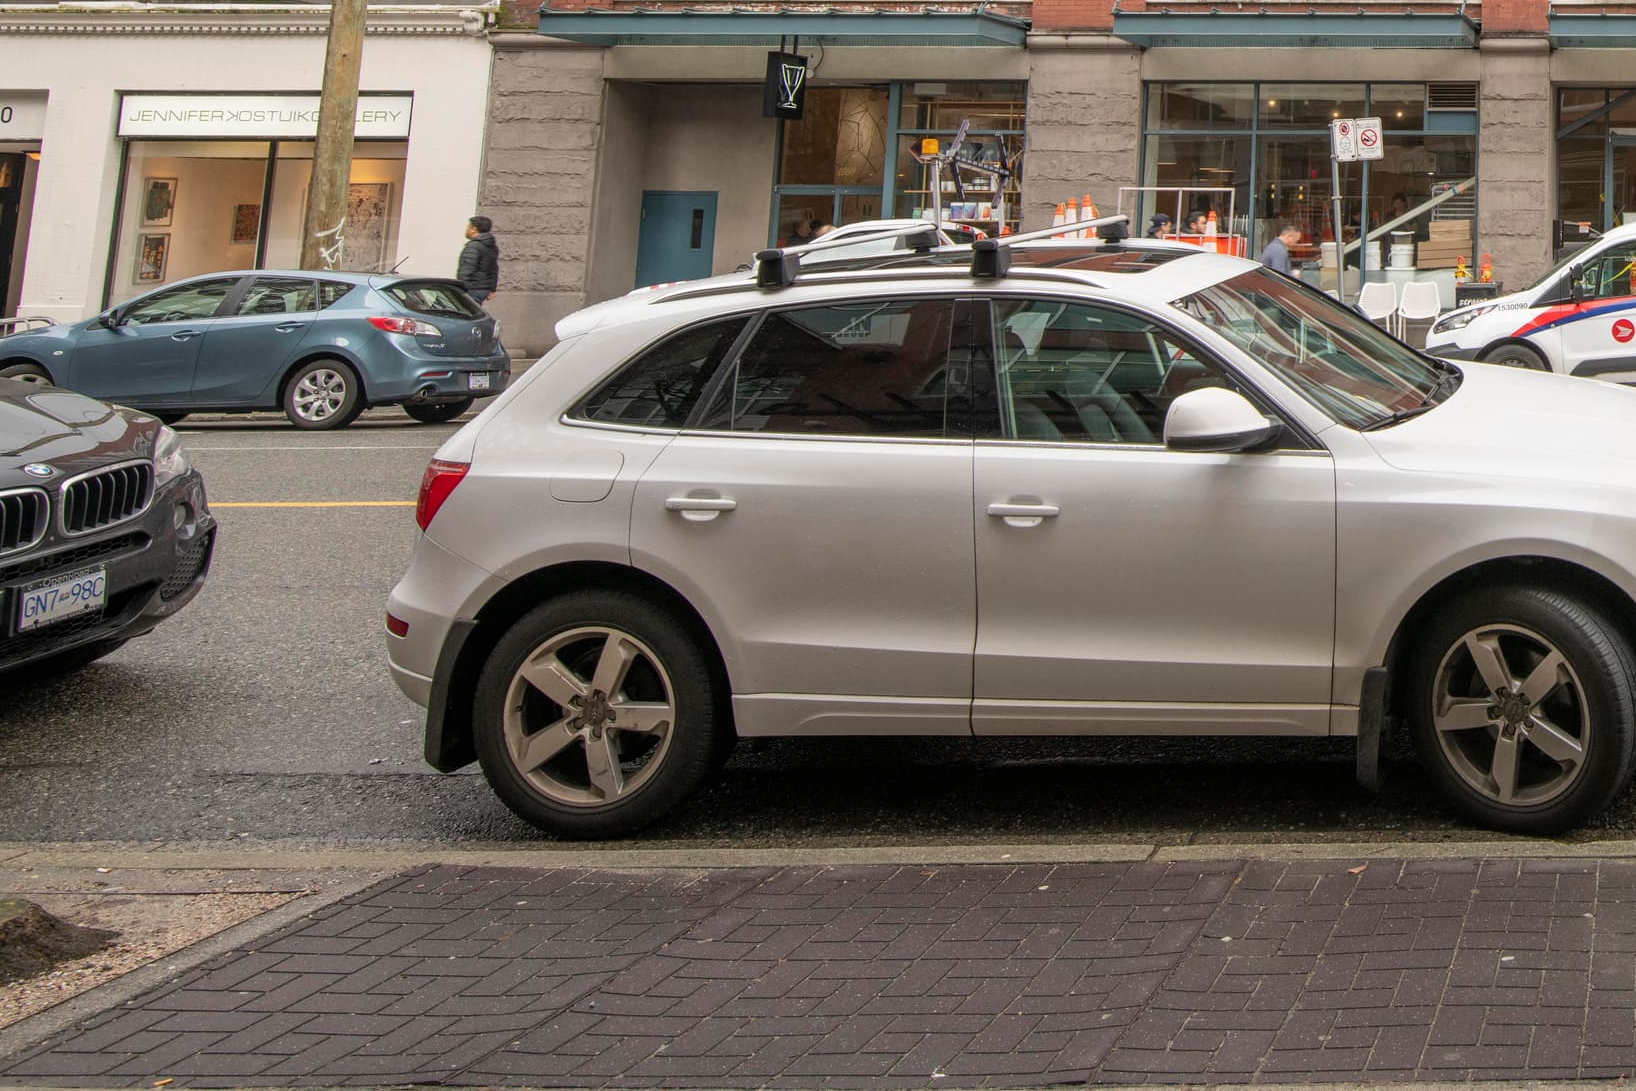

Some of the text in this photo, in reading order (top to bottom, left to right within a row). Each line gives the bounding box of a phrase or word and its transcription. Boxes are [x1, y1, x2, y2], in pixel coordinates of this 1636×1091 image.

[129, 110, 224, 122] JENNIFER
[24, 588, 60, 619] GN7
[70, 576, 105, 606] 98C
